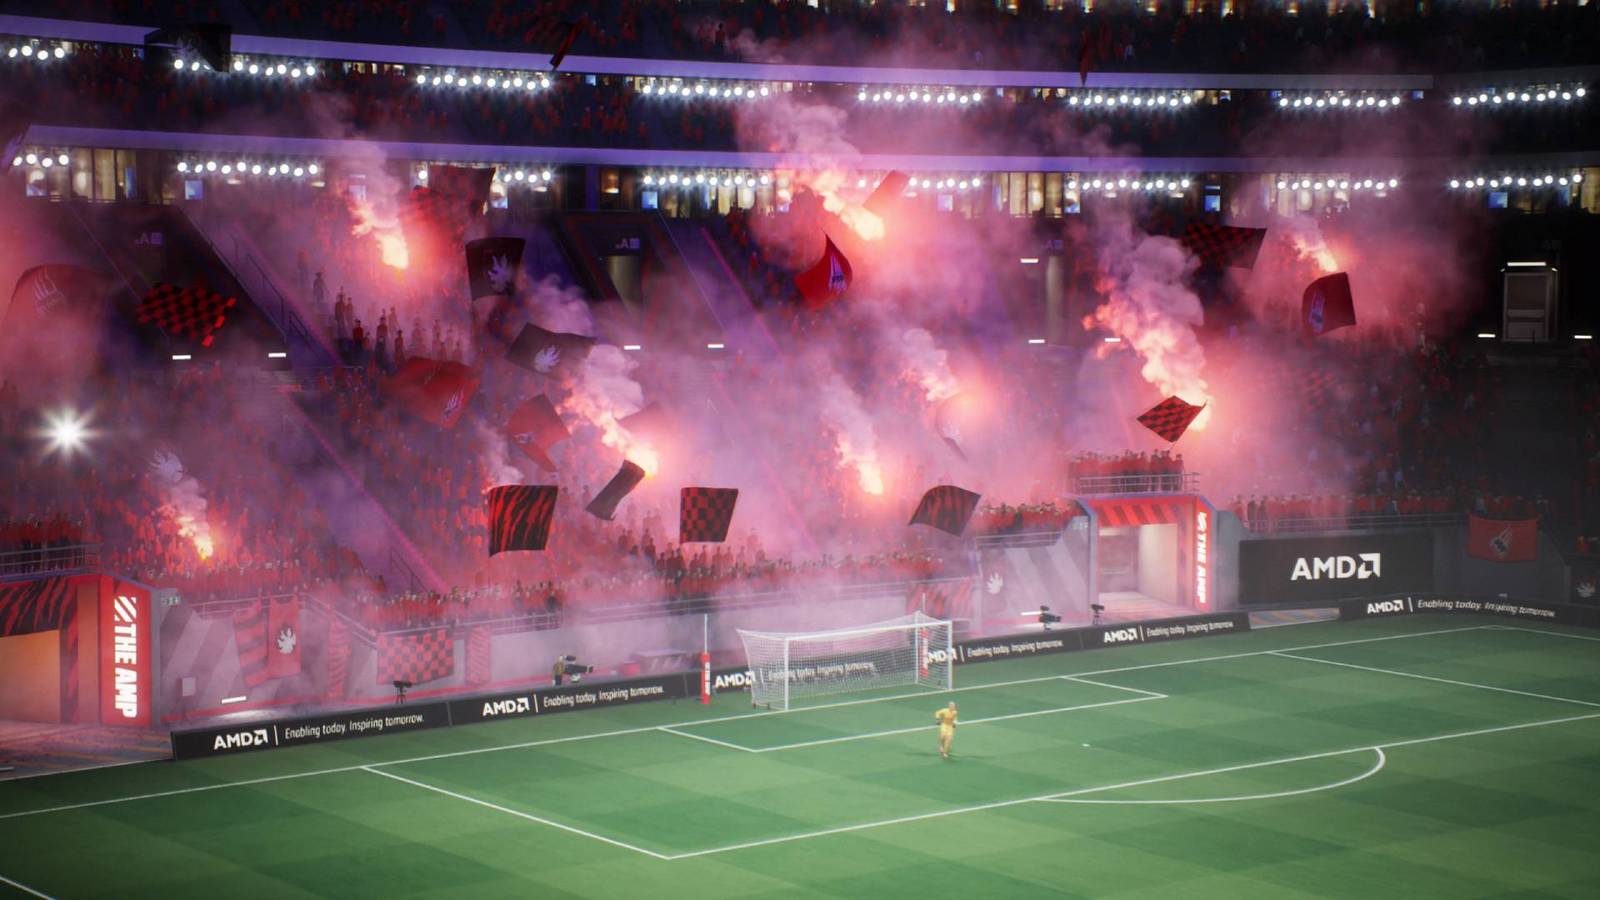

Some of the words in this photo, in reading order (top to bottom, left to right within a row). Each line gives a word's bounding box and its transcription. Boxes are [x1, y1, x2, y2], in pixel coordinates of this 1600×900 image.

[1290, 555, 1357, 581] AMD
[1367, 602, 1395, 614] AMD
[1417, 599, 1453, 610] Enabling
[1455, 600, 1482, 610] today.
[1485, 602, 1518, 616] Inspiring
[115, 623, 137, 665] THE
[1103, 630, 1128, 643] AMD
[115, 667, 137, 718] AMP
[715, 673, 747, 688] AMD
[482, 700, 518, 716] AMD
[543, 694, 575, 708] Enabling
[576, 693, 598, 705] today.
[599, 687, 629, 701] Inspiring
[630, 685, 664, 697] tomorrow.
[214, 731, 252, 750] AMD
[285, 726, 321, 740] Enabling
[322, 723, 346, 738] today.
[350, 719, 383, 732] Inspiring
[385, 713, 425, 727] tomorrow.
